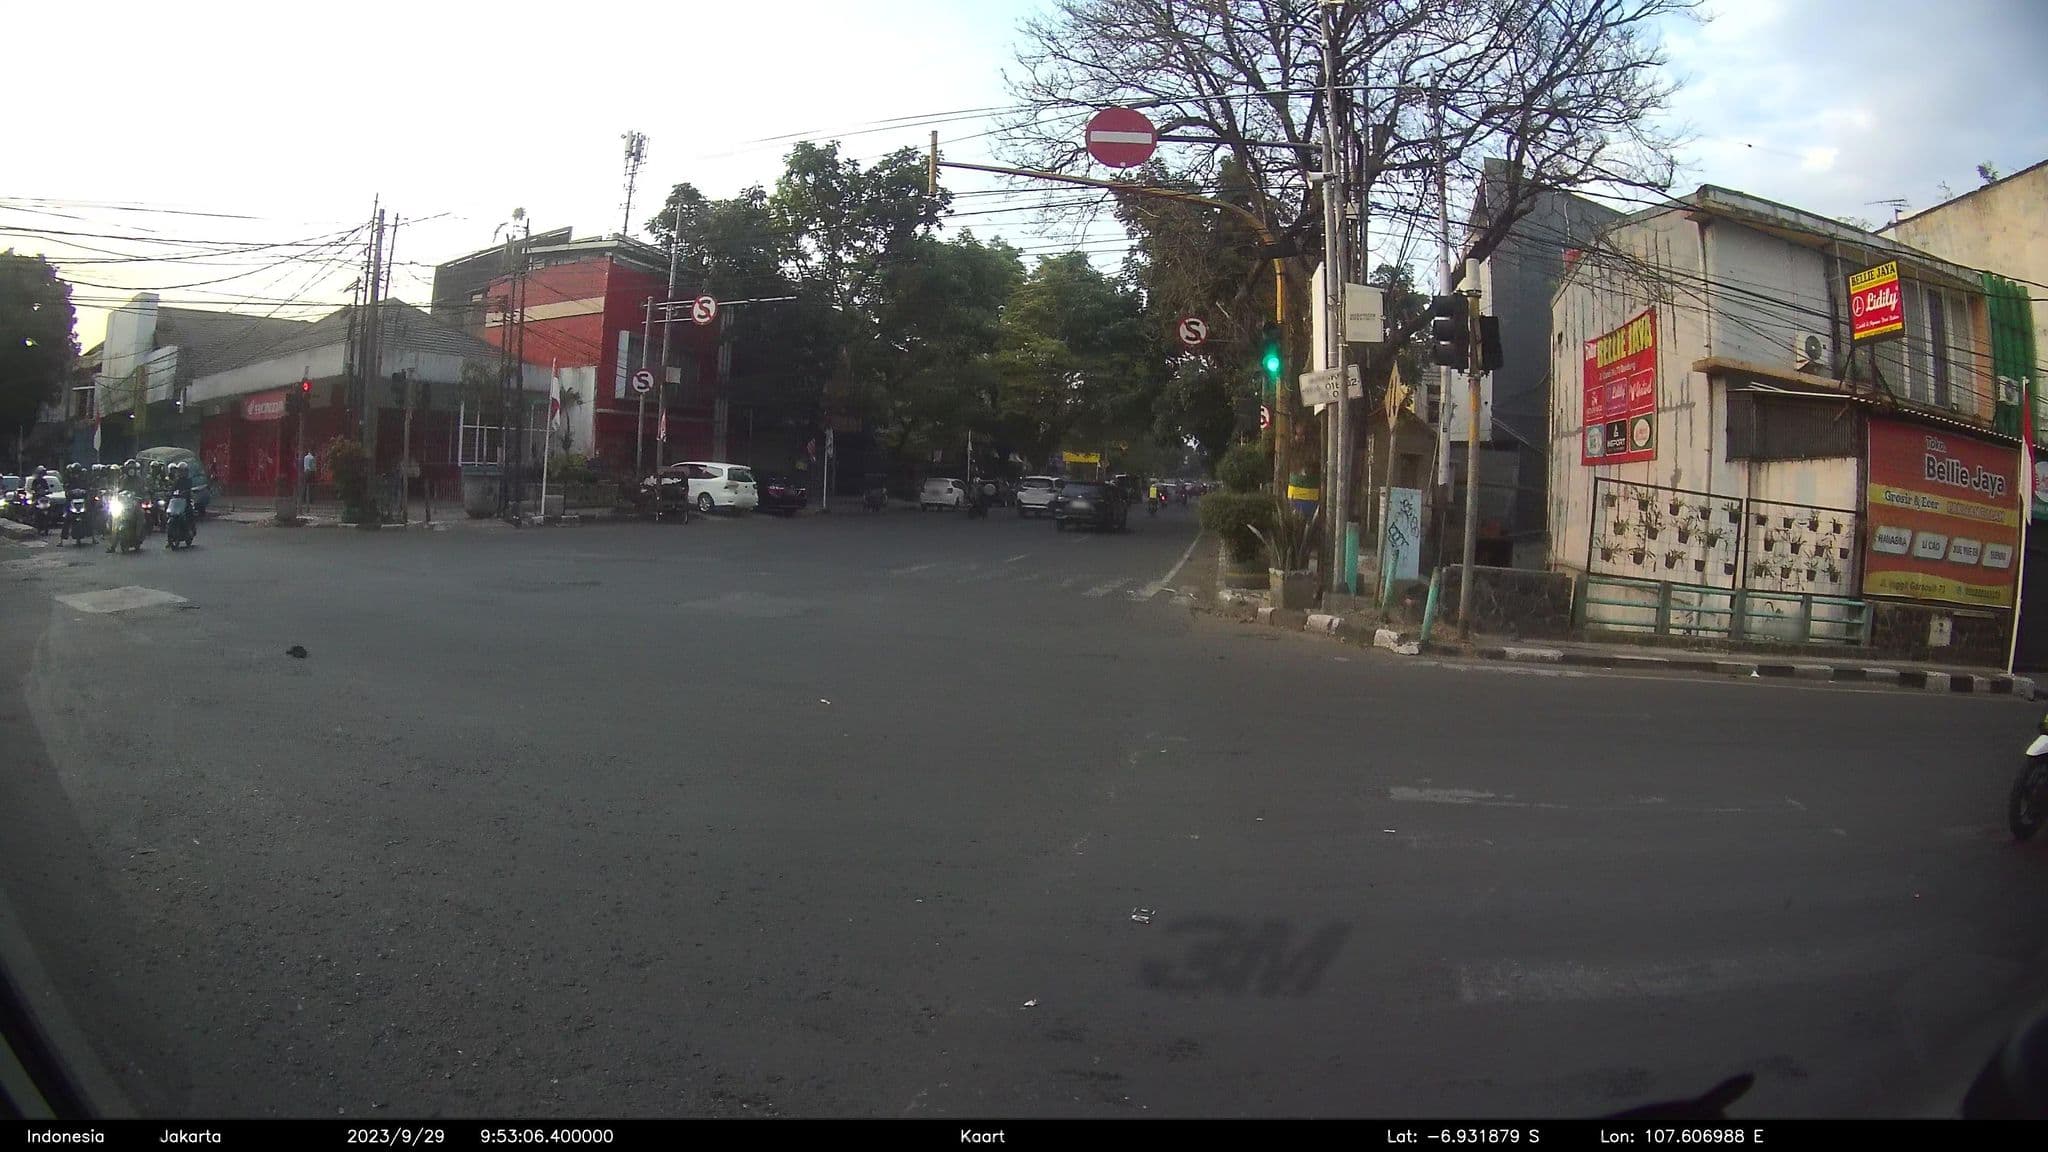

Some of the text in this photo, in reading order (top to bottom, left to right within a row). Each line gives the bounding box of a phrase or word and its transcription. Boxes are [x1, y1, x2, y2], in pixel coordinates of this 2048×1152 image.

[1851, 263, 1896, 286] BELLIE JAYA
[1866, 287, 1899, 311] Lidily
[1597, 327, 1626, 369] BELLIE
[1628, 313, 1652, 355] JAYA
[1925, 454, 2005, 498] Bellie Jaya
[1884, 490, 1939, 510] Grosir & Ecer
